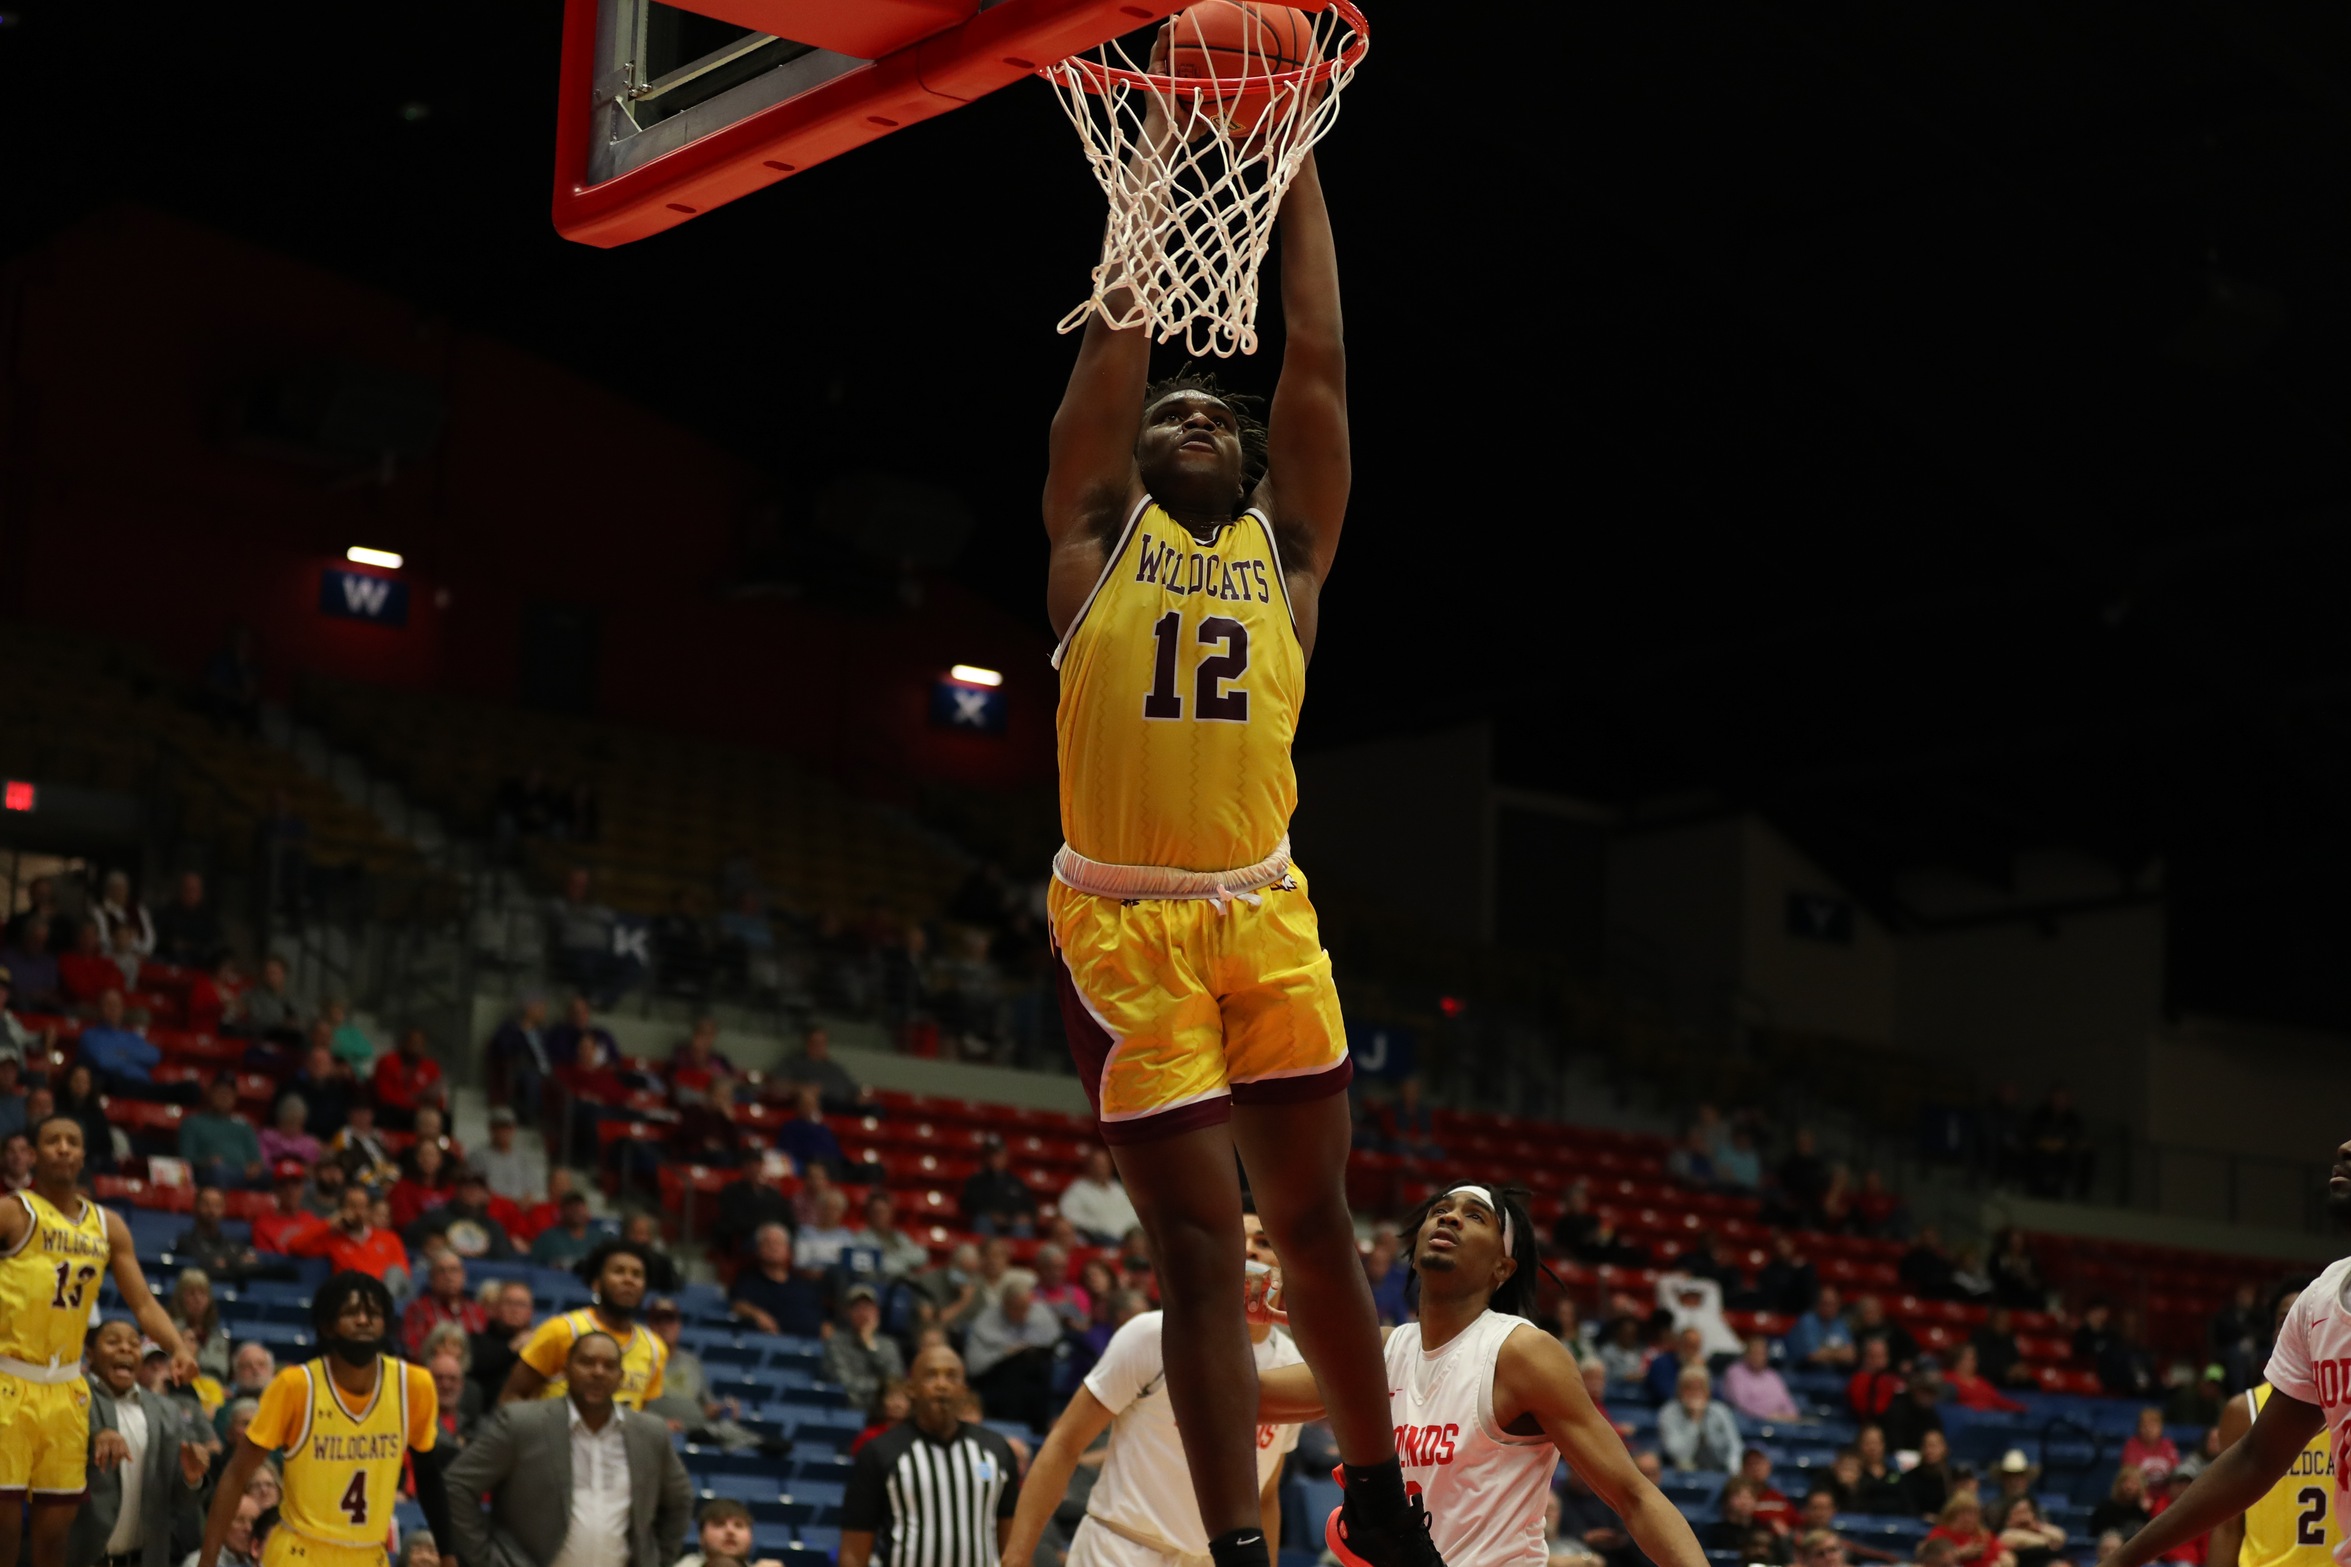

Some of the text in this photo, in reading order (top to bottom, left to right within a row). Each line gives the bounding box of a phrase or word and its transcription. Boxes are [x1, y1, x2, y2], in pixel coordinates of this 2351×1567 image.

[1136, 533, 1269, 604] WILDCATS
[342, 573, 391, 617] W
[1142, 610, 1249, 721] 12
[952, 688, 989, 728] X
[613, 922, 652, 968] K
[1355, 1031, 1389, 1073] J
[313, 1433, 399, 1461] WILDCATS
[339, 1469, 368, 1526] 4
[2296, 1486, 2328, 1546] 2
